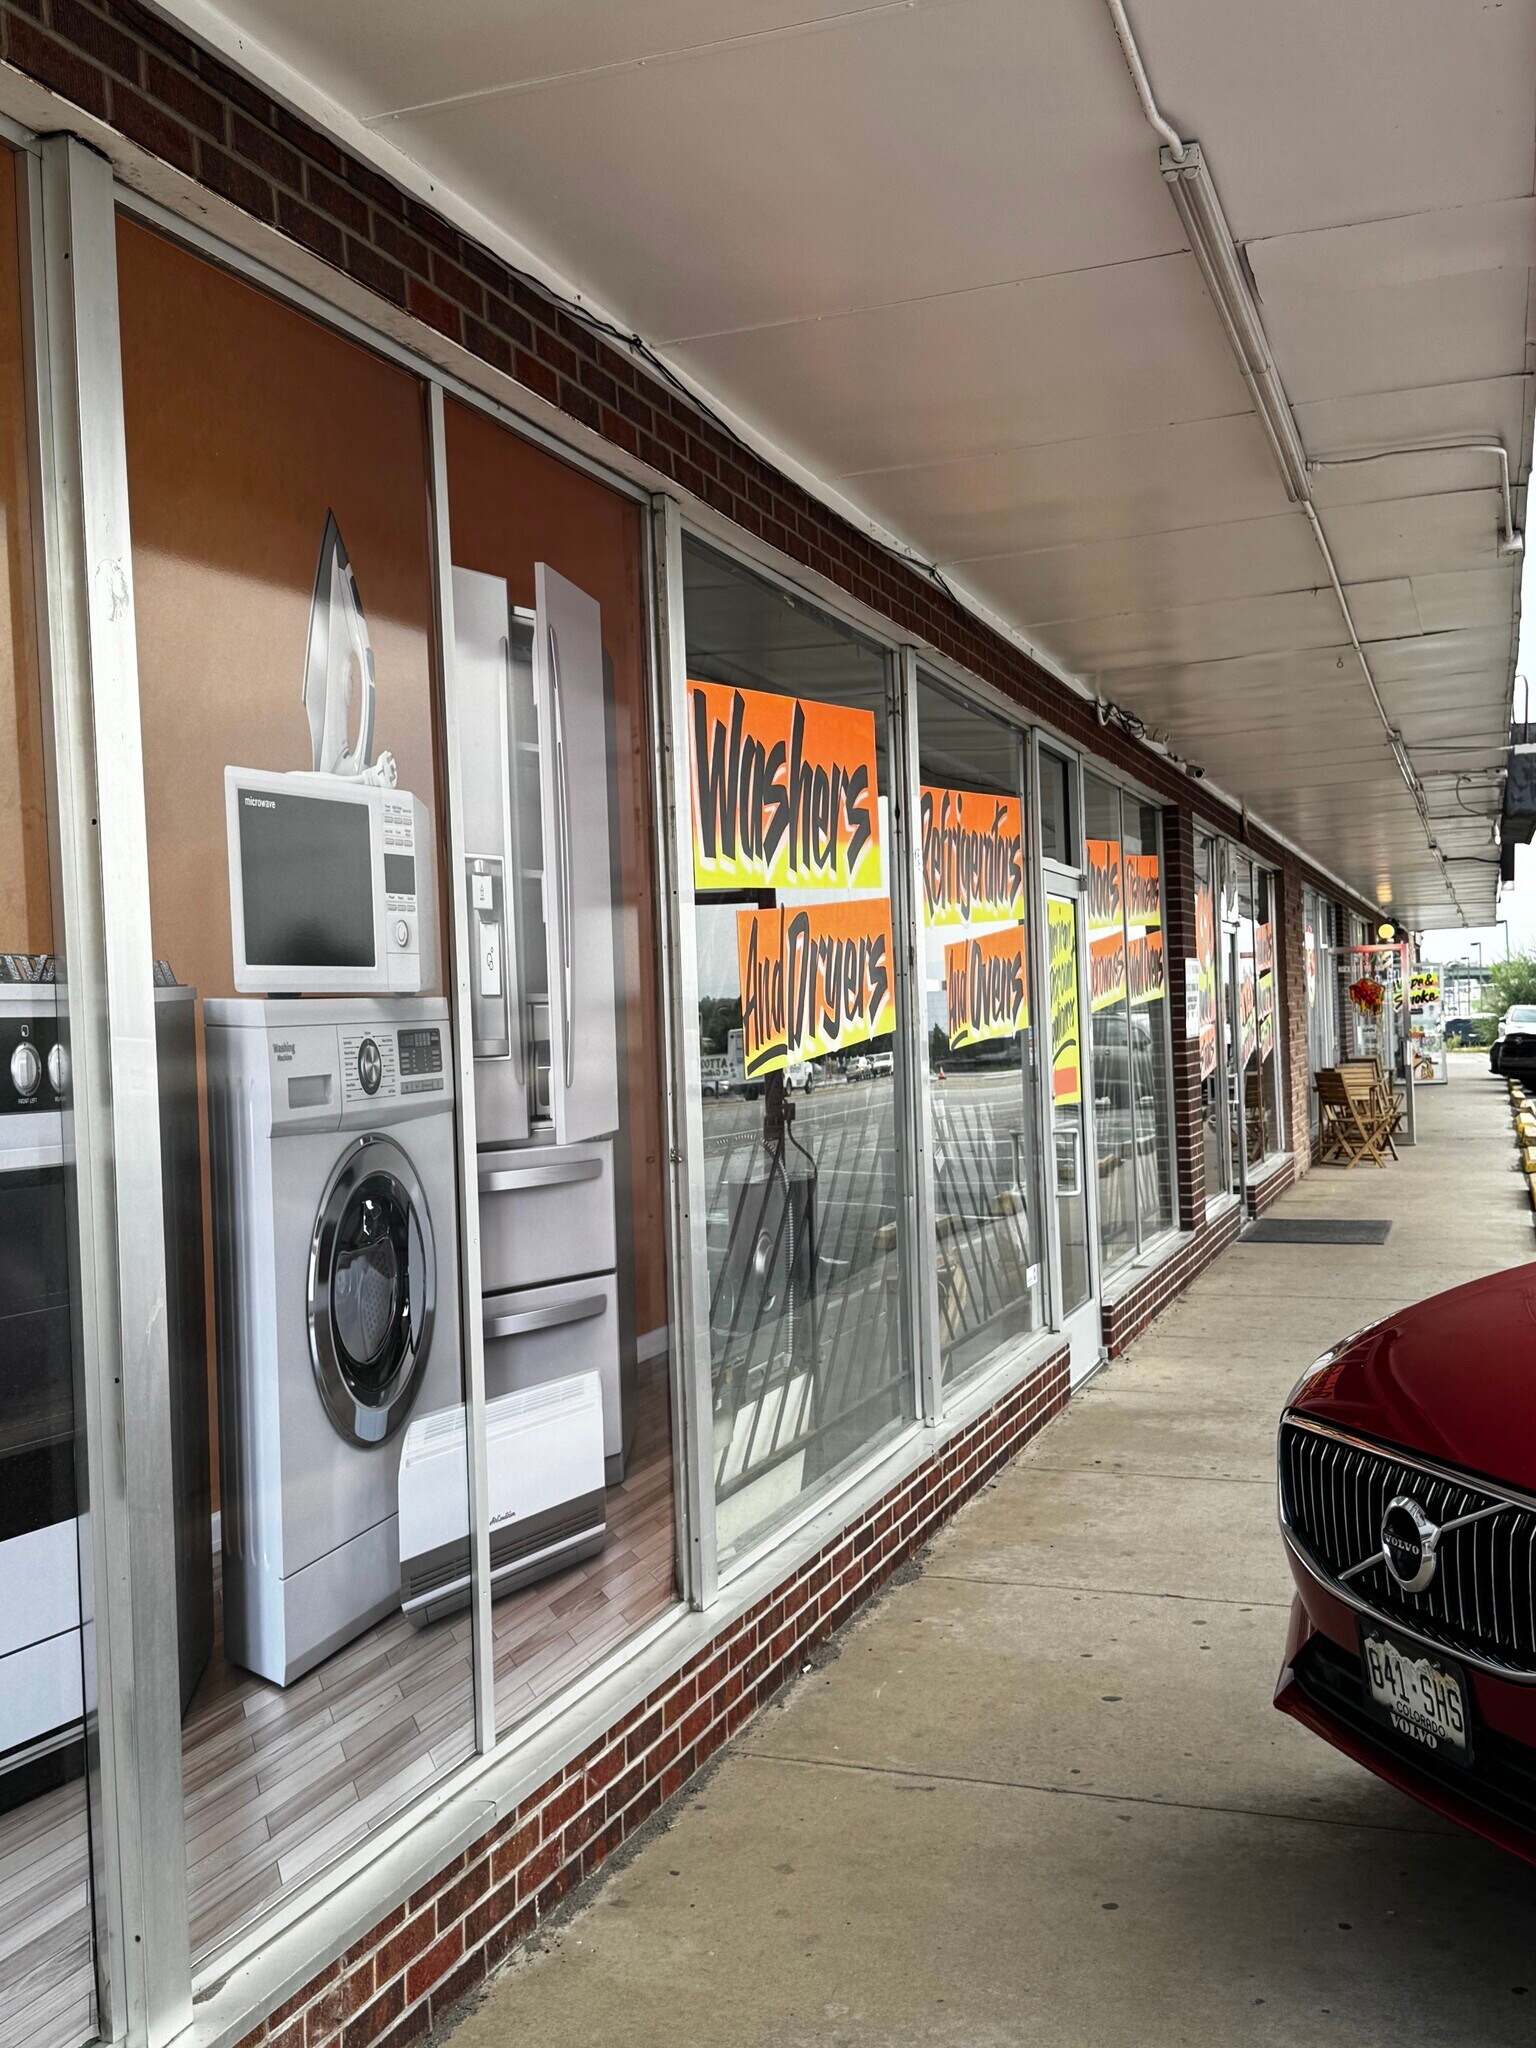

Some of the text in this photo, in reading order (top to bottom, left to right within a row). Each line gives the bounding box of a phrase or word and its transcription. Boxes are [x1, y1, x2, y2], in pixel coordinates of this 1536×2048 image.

[693, 689, 871, 874] Washers
[244, 796, 276, 809] microwave
[743, 902, 888, 1057] And Dryers
[949, 938, 968, 1040] And
[969, 939, 1024, 1030] Ovens
[272, 1042, 296, 1055] Washing
[1383, 1533, 1420, 1555] VOLVO
[1390, 1712, 1438, 1749] VOLVO
[1396, 1701, 1446, 1737] COLORADO
